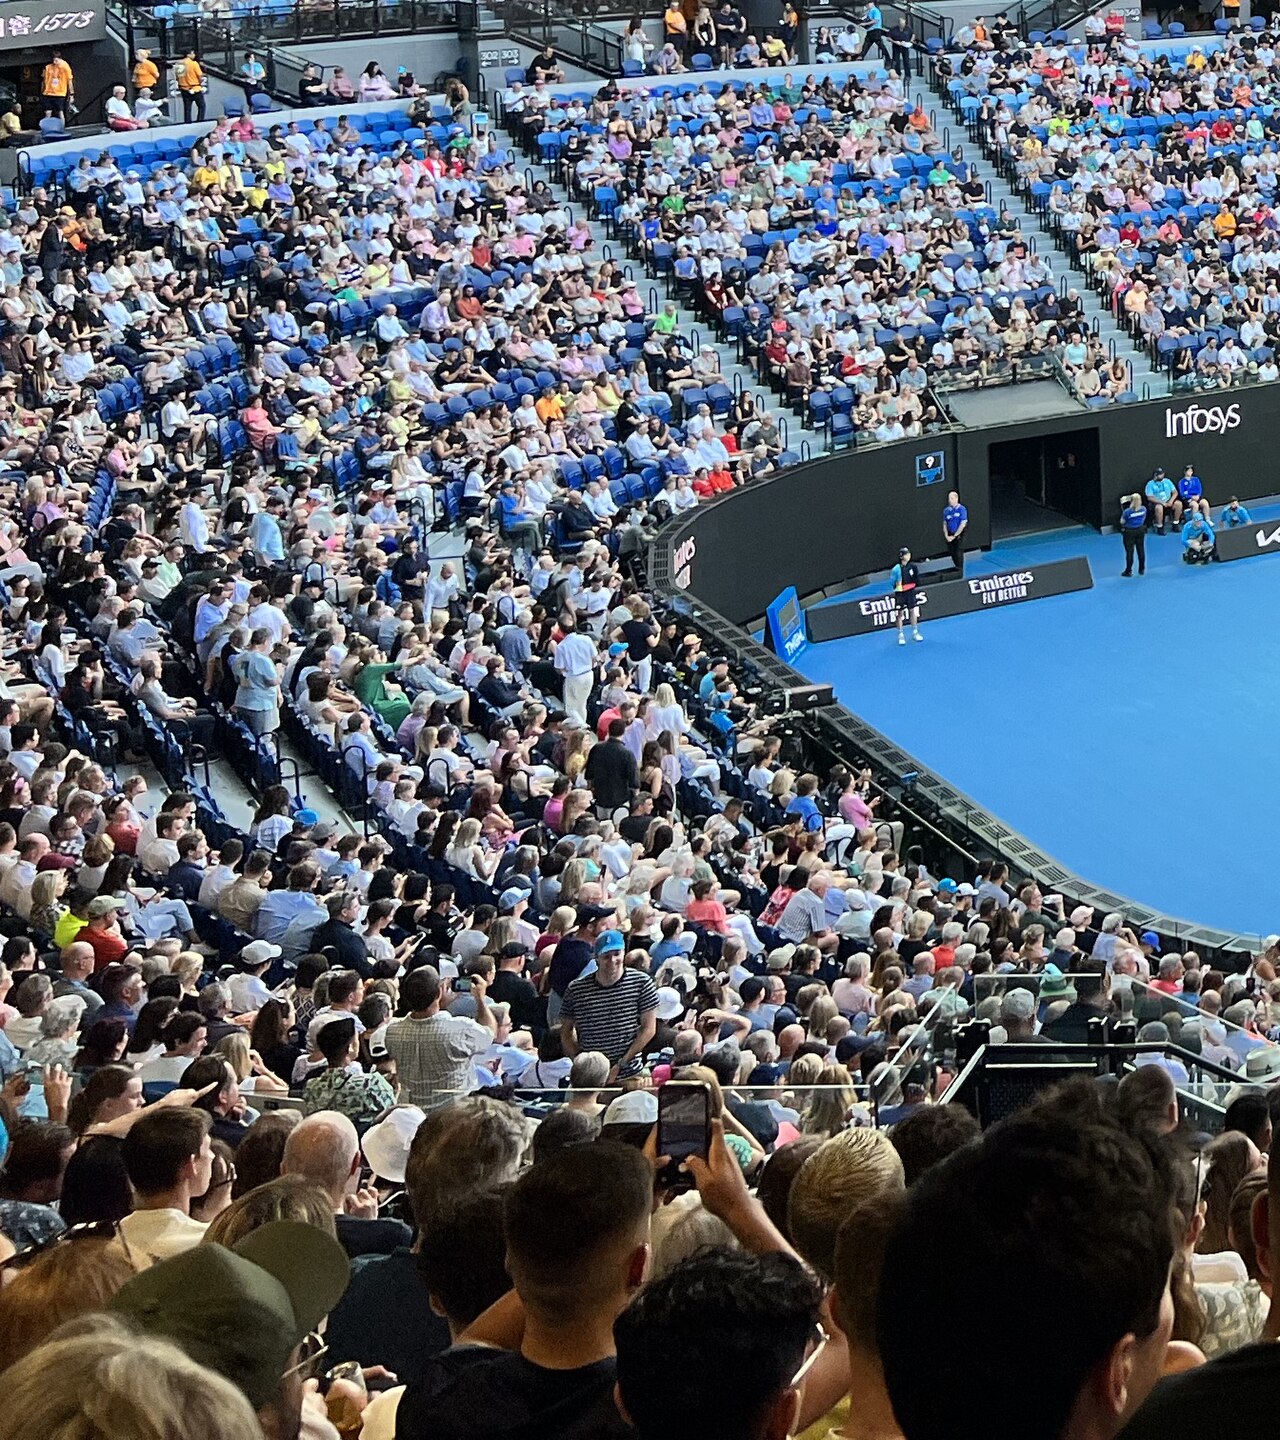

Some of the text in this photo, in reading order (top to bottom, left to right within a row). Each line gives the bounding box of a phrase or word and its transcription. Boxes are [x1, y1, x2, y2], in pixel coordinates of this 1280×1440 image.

[33, 10, 95, 33] 1573
[480, 49, 519, 60] 302 303
[1166, 404, 1241, 438] Infosys
[925, 455, 935, 468] 9
[969, 571, 1034, 594] Emirates
[982, 585, 1028, 605] FLY BETTER
[873, 611, 888, 626] FLY
